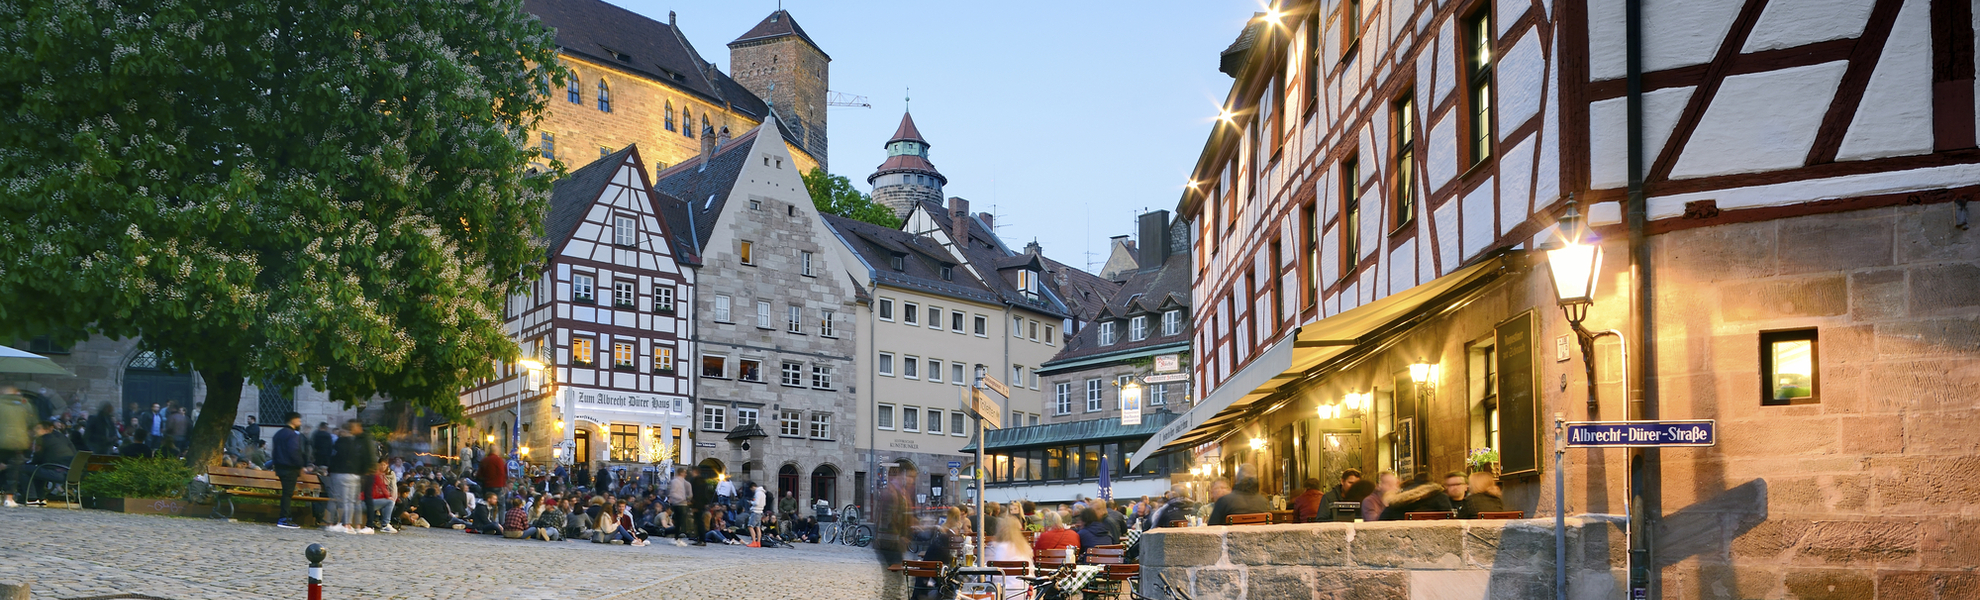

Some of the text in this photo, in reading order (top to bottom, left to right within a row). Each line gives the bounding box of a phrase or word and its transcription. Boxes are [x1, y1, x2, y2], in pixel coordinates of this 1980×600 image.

[578, 391, 670, 409] Zum Albrecht Dürer Haus
[1572, 426, 1708, 443] Albrecht-Dürer-Straße
